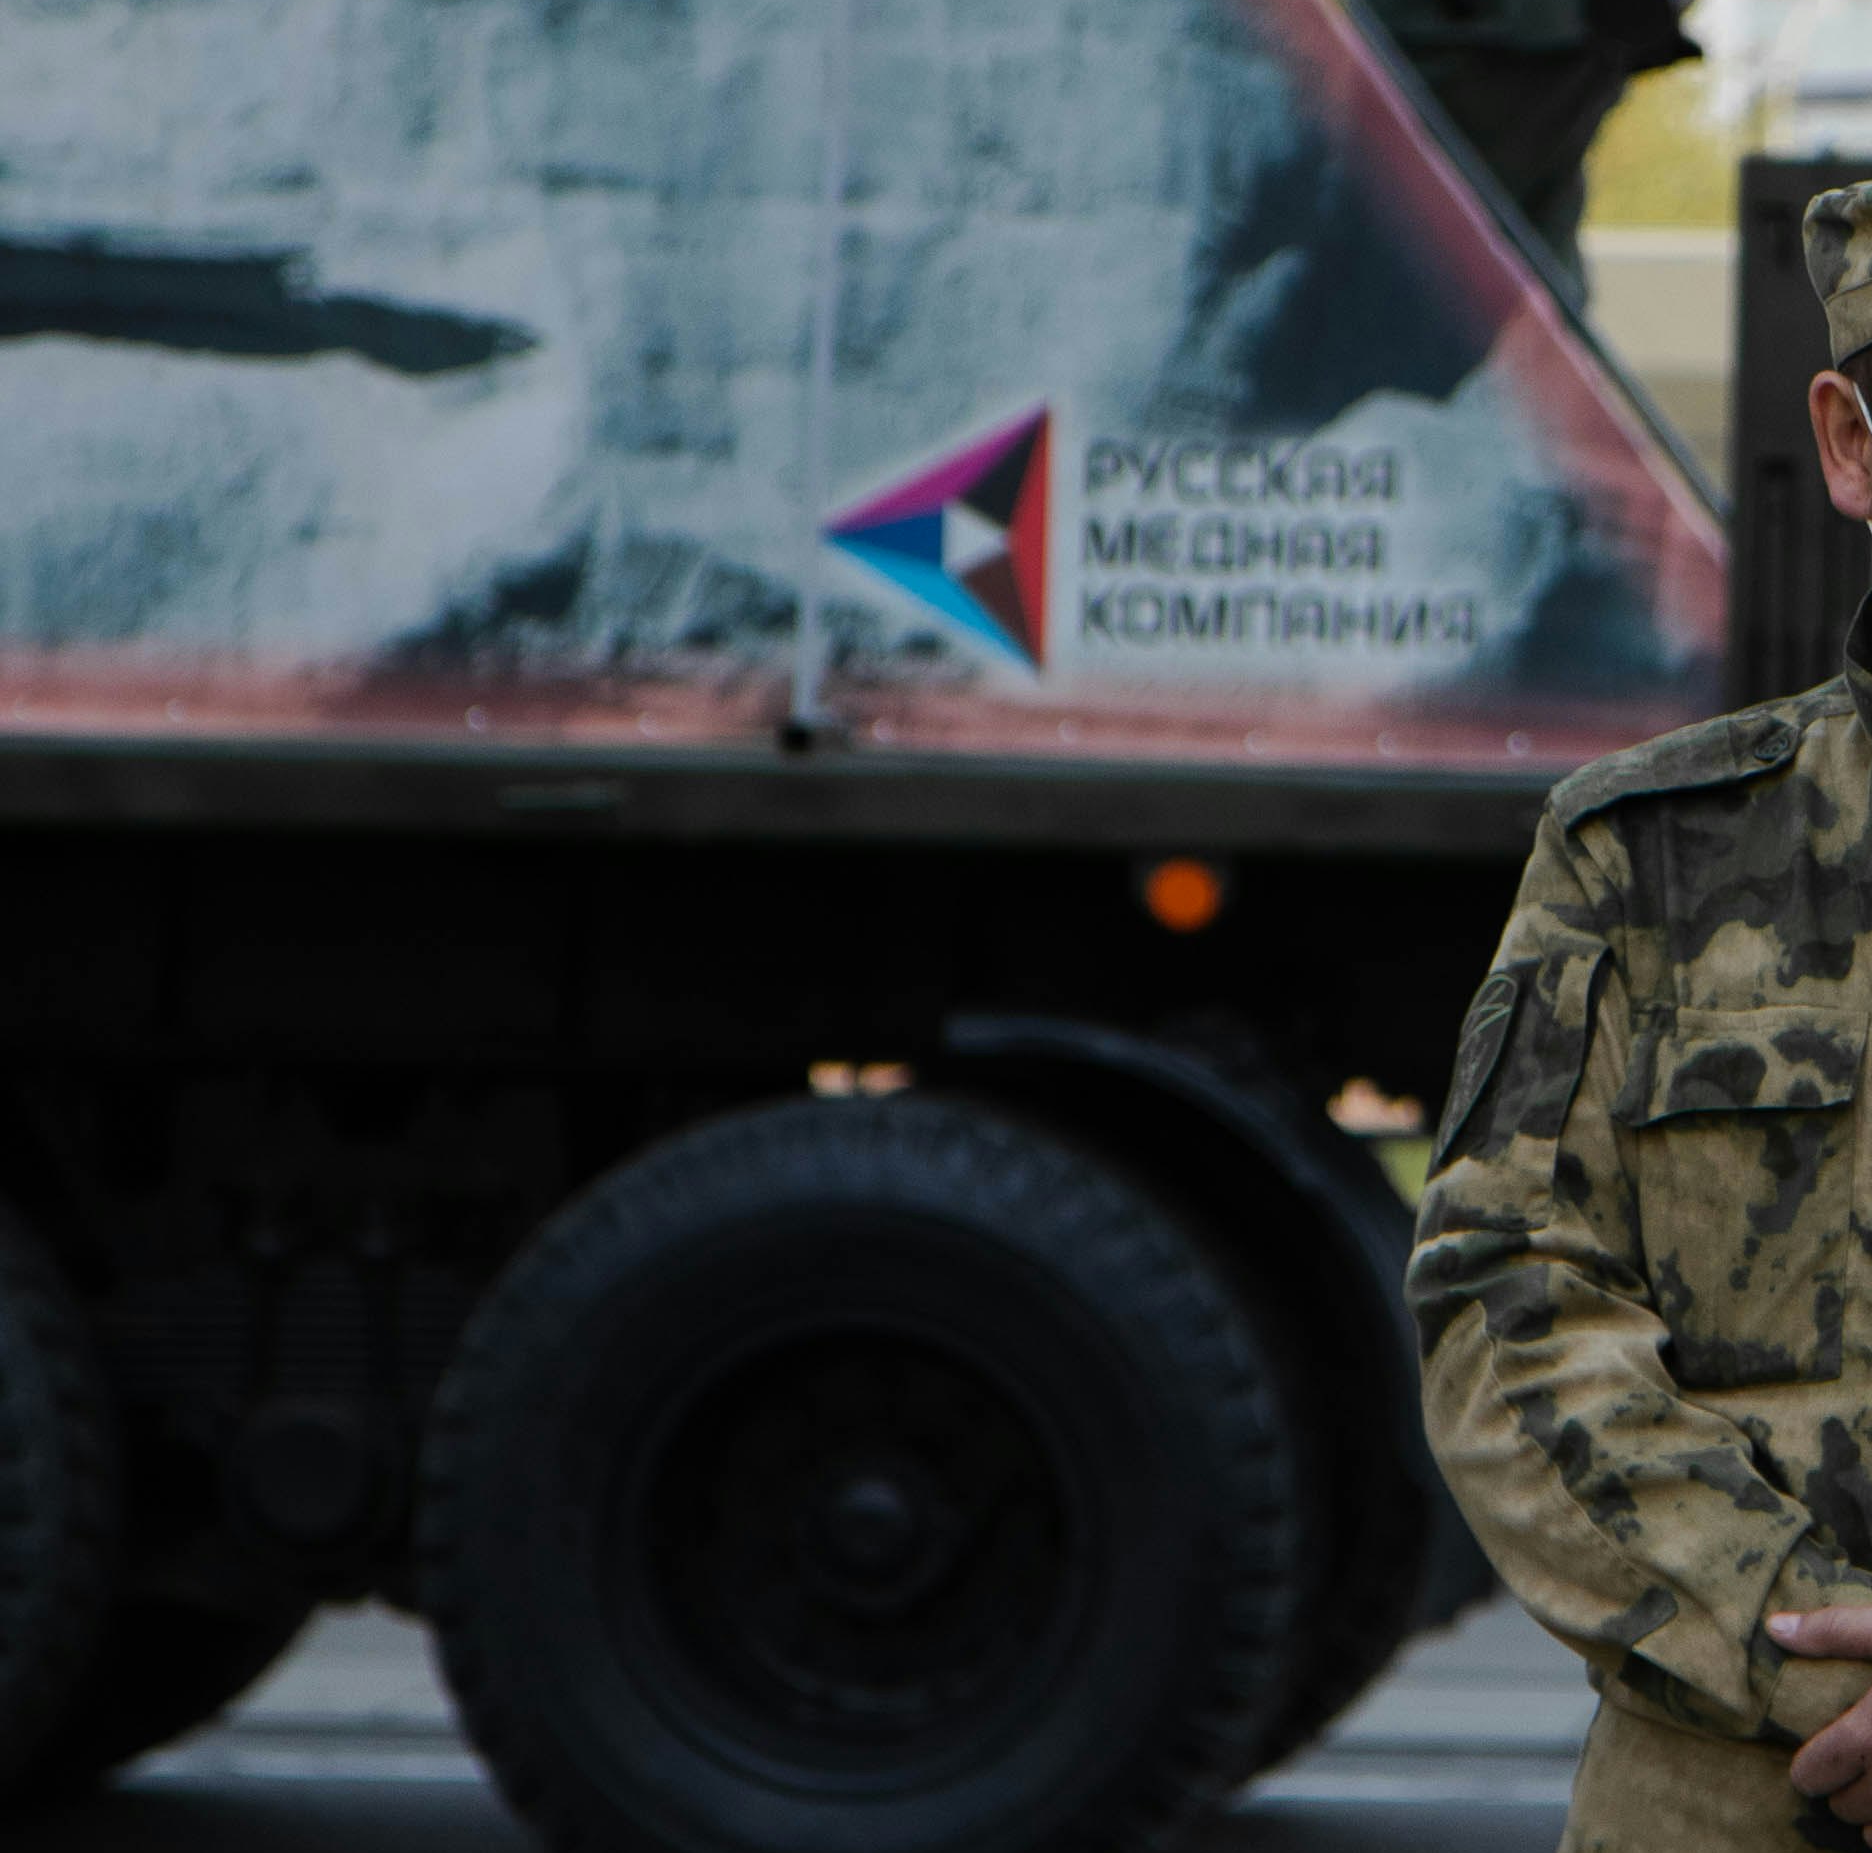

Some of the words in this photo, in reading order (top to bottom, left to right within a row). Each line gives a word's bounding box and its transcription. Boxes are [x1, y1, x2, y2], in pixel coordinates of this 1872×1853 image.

[1083, 437, 1399, 502] РУССКАЯ
[1082, 512, 1384, 574] МЕДНАЯ
[1080, 583, 1478, 645] КОМПАНИЯ
